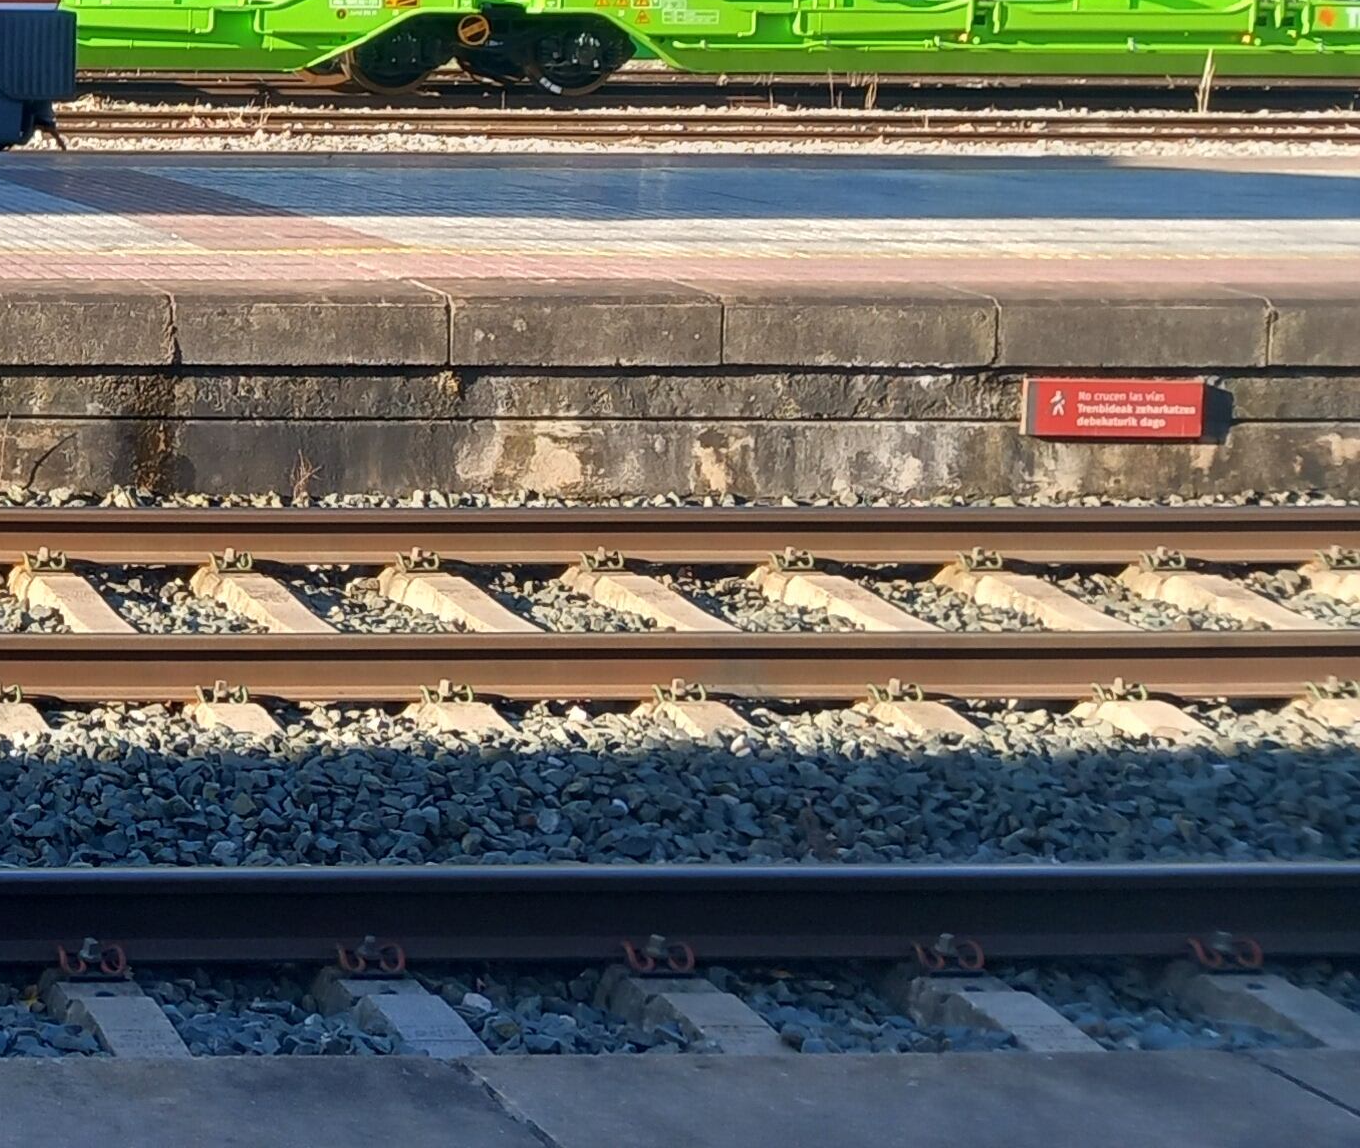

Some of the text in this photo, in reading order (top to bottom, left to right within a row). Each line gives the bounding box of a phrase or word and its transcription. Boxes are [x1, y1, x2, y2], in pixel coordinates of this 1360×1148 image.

[1078, 391, 1092, 401] No
[1093, 393, 1127, 402] crucen
[1128, 392, 1143, 402] las
[1077, 403, 1133, 414] Trenbideak
[1139, 417, 1167, 429] dago
